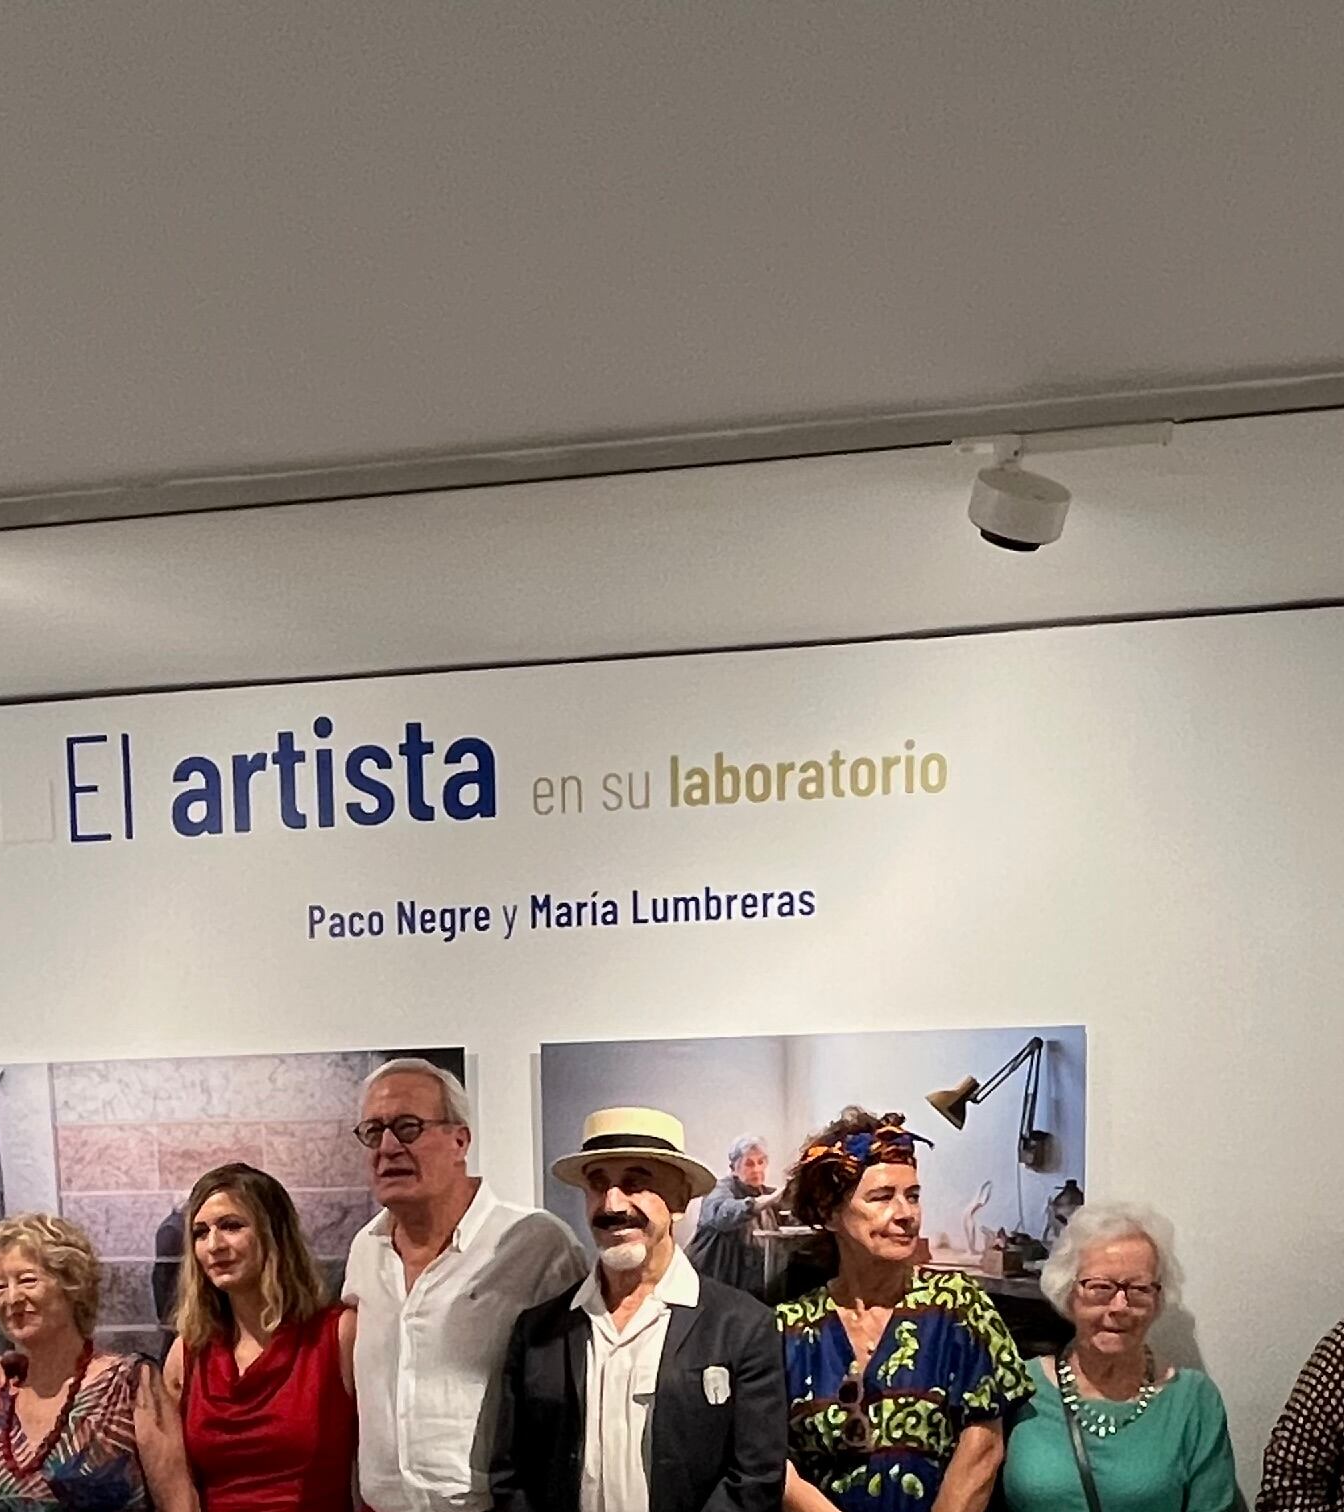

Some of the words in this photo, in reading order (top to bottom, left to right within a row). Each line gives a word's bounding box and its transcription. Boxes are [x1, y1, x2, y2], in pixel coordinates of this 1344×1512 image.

[66, 732, 134, 843] El
[171, 716, 497, 838] artista
[532, 775, 583, 816] en
[602, 771, 651, 812] su
[669, 739, 948, 808] laboratorio
[308, 904, 384, 940] Paco
[396, 900, 491, 943] Negre
[502, 904, 519, 940] y
[530, 890, 619, 930] María
[631, 885, 816, 925] Lumbreras
